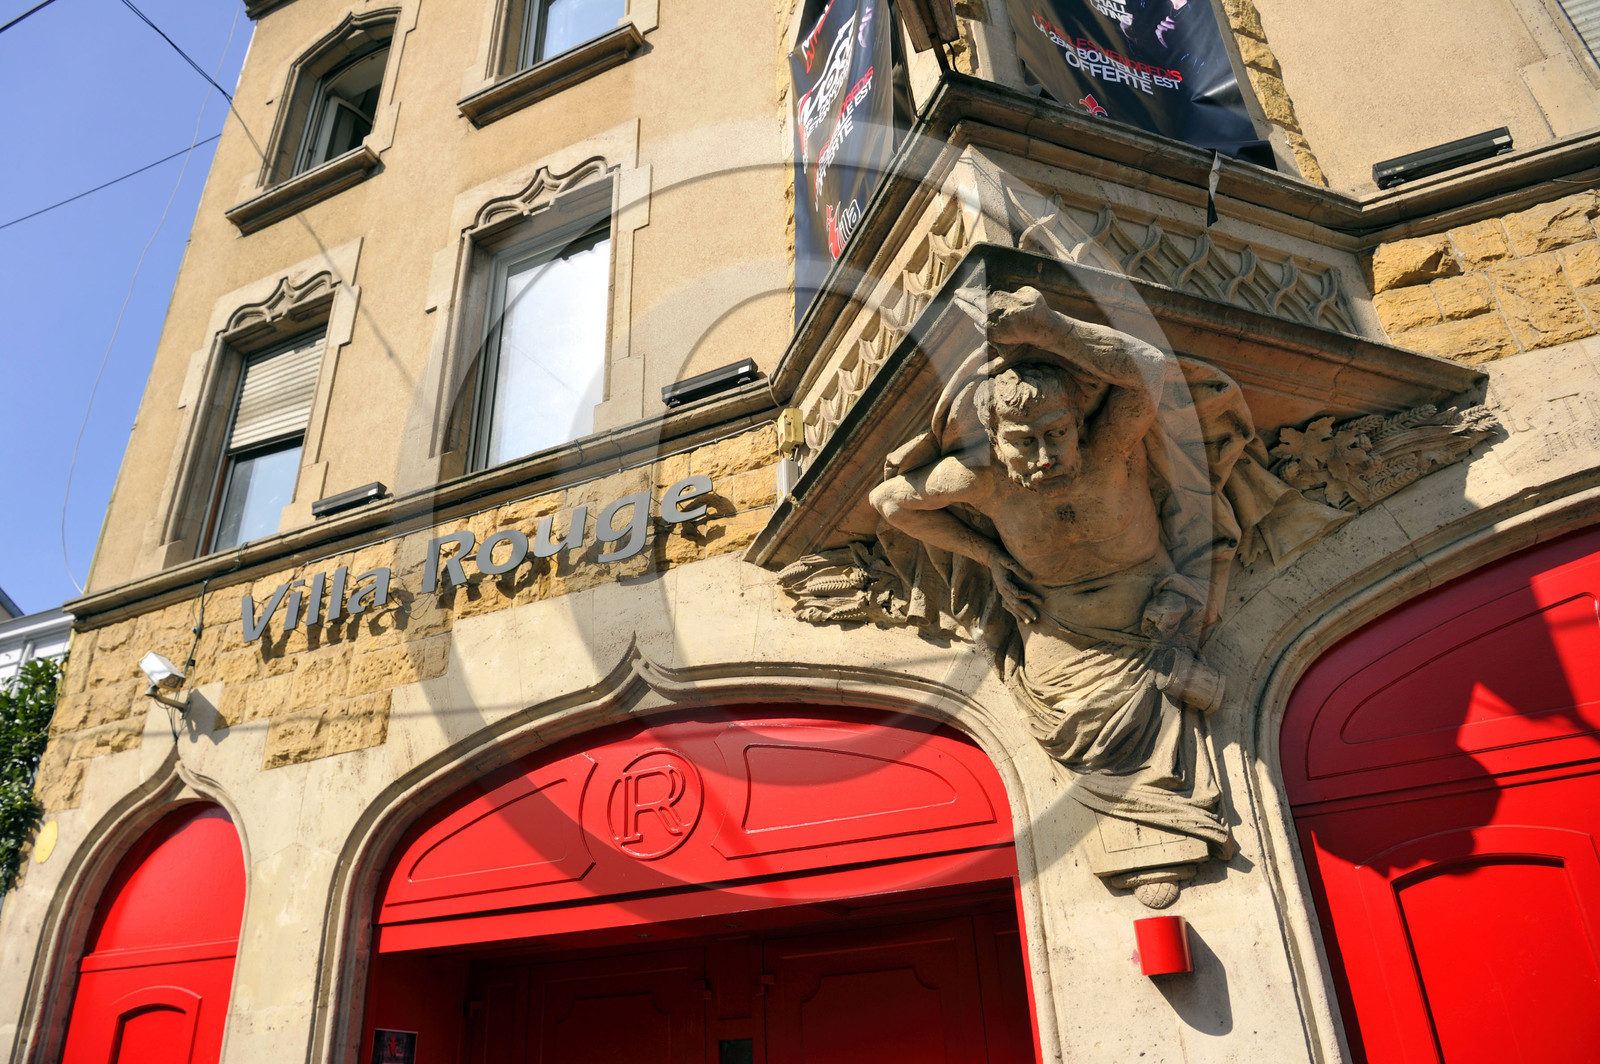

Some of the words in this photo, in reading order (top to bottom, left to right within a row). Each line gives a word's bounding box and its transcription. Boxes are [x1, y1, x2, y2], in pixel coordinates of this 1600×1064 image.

[1066, 50, 1154, 95] OFFERTE
[1077, 48, 1152, 83] BOUTEILLE
[1153, 74, 1181, 90] EST
[854, 76, 873, 107] EST
[241, 566, 391, 643] Villa
[422, 475, 713, 594] Rouge
